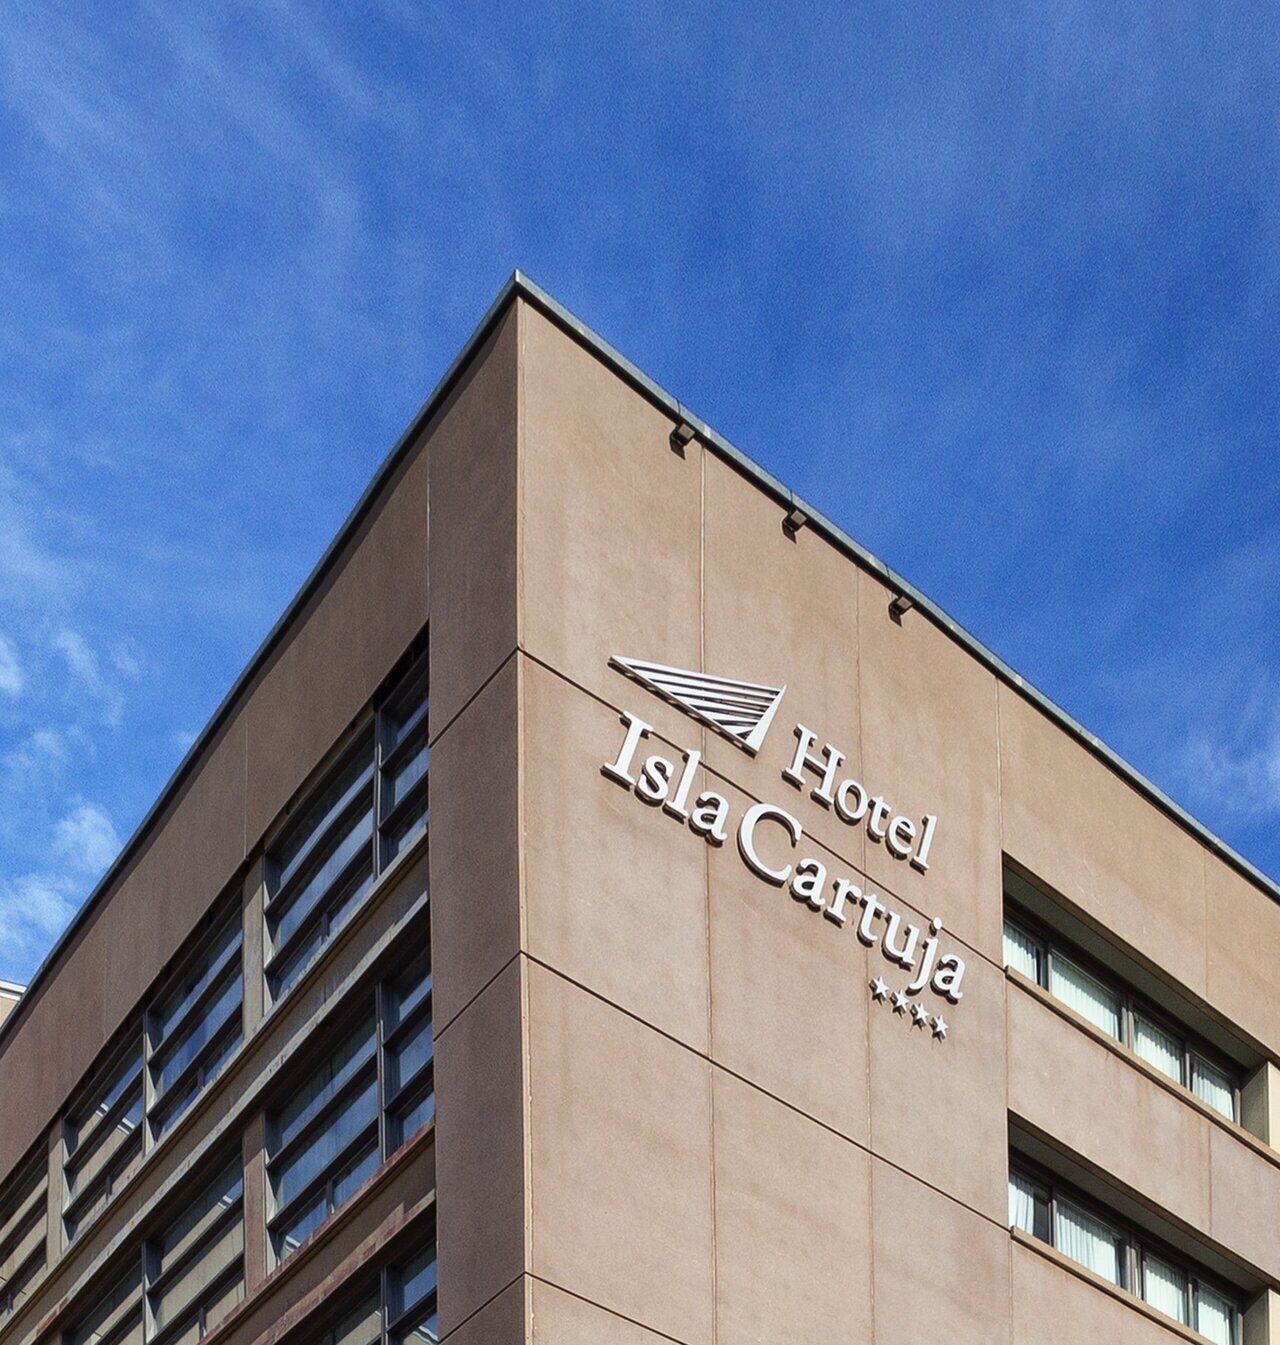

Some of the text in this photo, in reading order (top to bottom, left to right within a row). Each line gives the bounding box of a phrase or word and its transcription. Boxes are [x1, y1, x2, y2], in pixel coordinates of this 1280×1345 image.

[601, 711, 968, 1002] Isla Cartuja
[782, 723, 939, 872] Hotel
